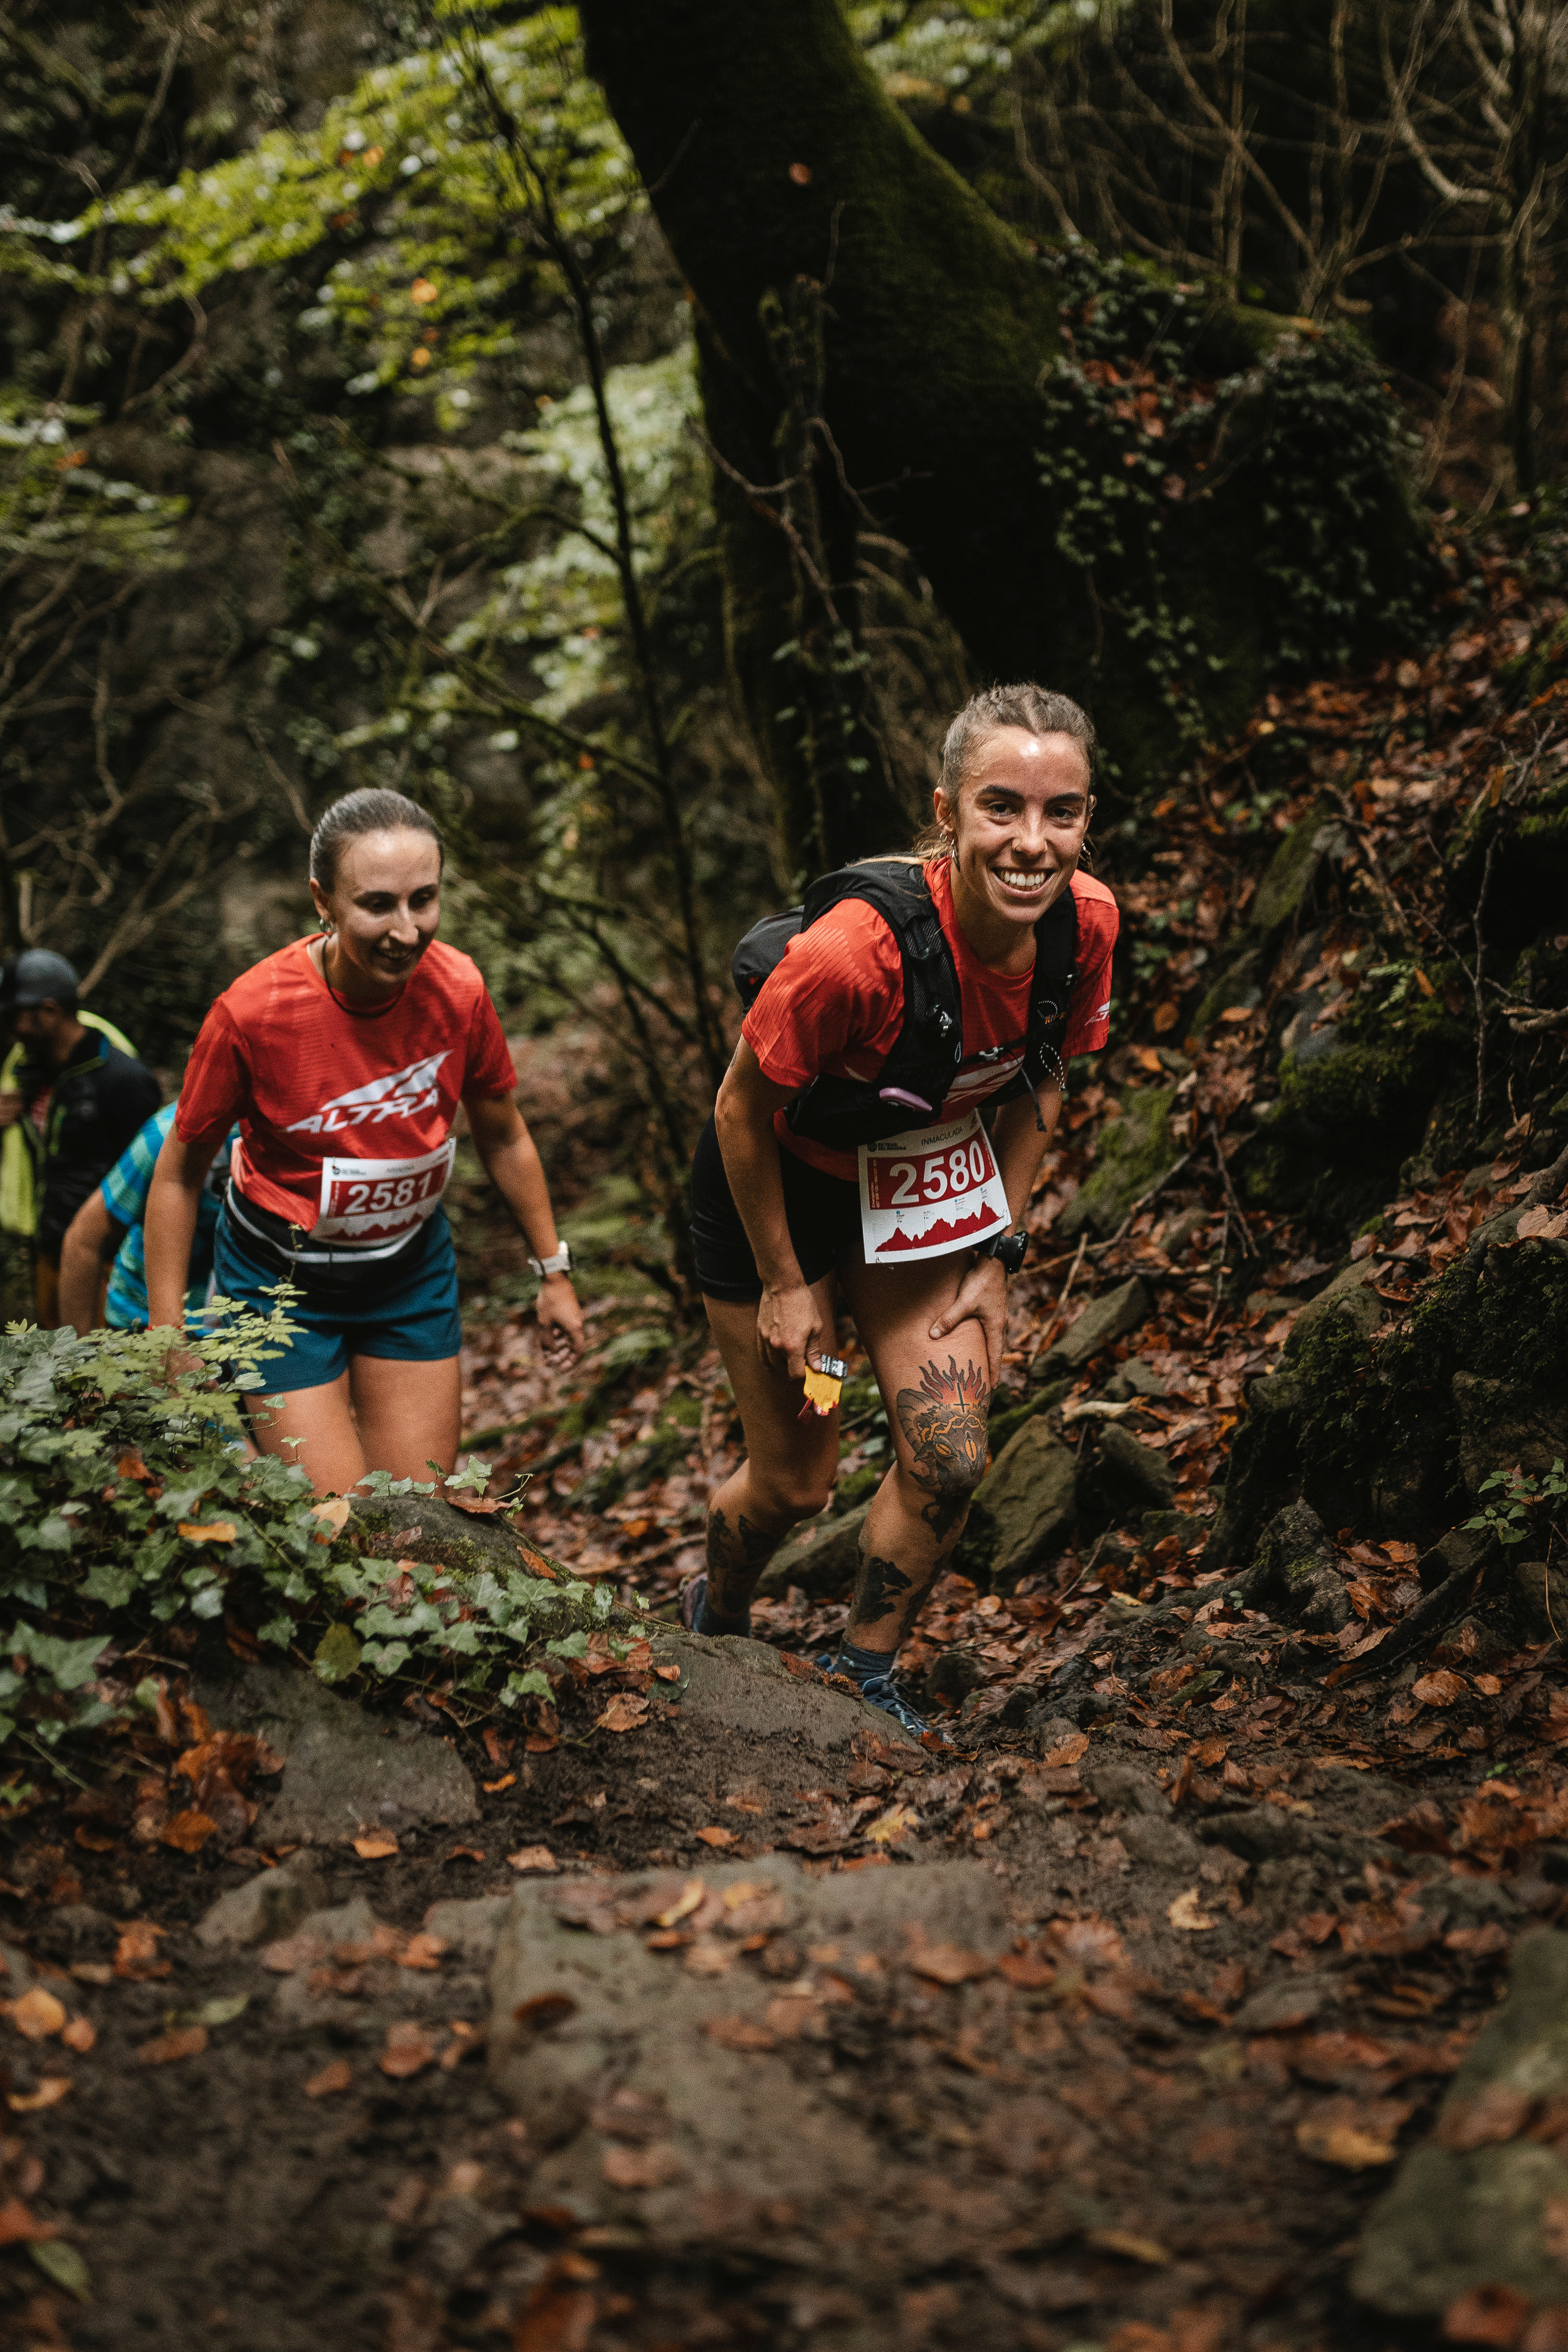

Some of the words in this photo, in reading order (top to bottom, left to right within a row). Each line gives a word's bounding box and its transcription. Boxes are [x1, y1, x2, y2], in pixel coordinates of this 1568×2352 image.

[285, 1087, 439, 1134] ALTRA
[921, 1126, 963, 1146] INMACULADA
[343, 1169, 433, 1215] 2581
[889, 1140, 985, 1205] 2580
